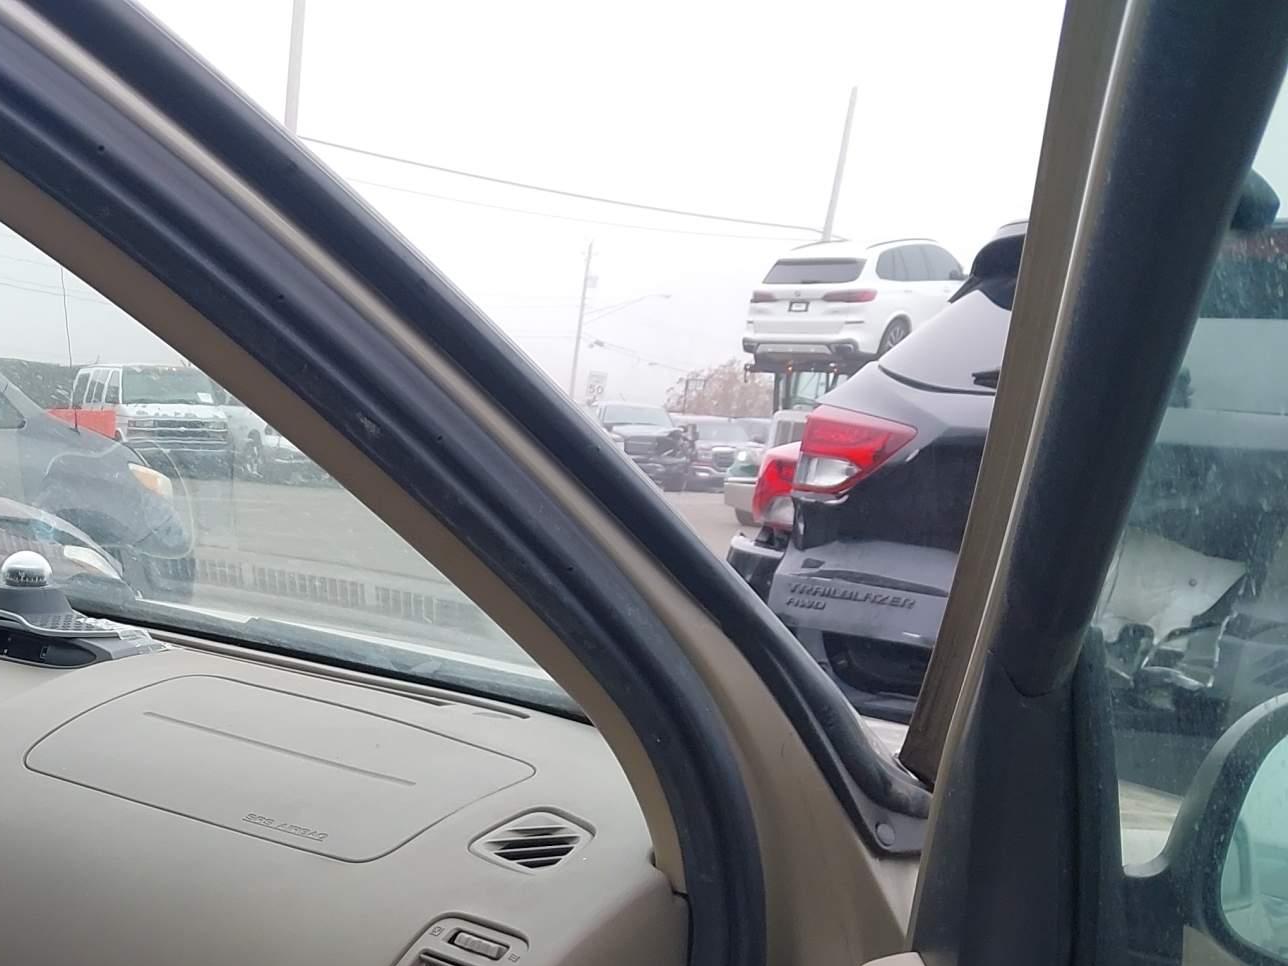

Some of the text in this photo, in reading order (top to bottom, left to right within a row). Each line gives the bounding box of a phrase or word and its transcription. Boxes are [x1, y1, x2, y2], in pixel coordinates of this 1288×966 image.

[589, 384, 604, 395] 50
[789, 583, 917, 609] TRAILBLAZER
[786, 598, 827, 611] AWD
